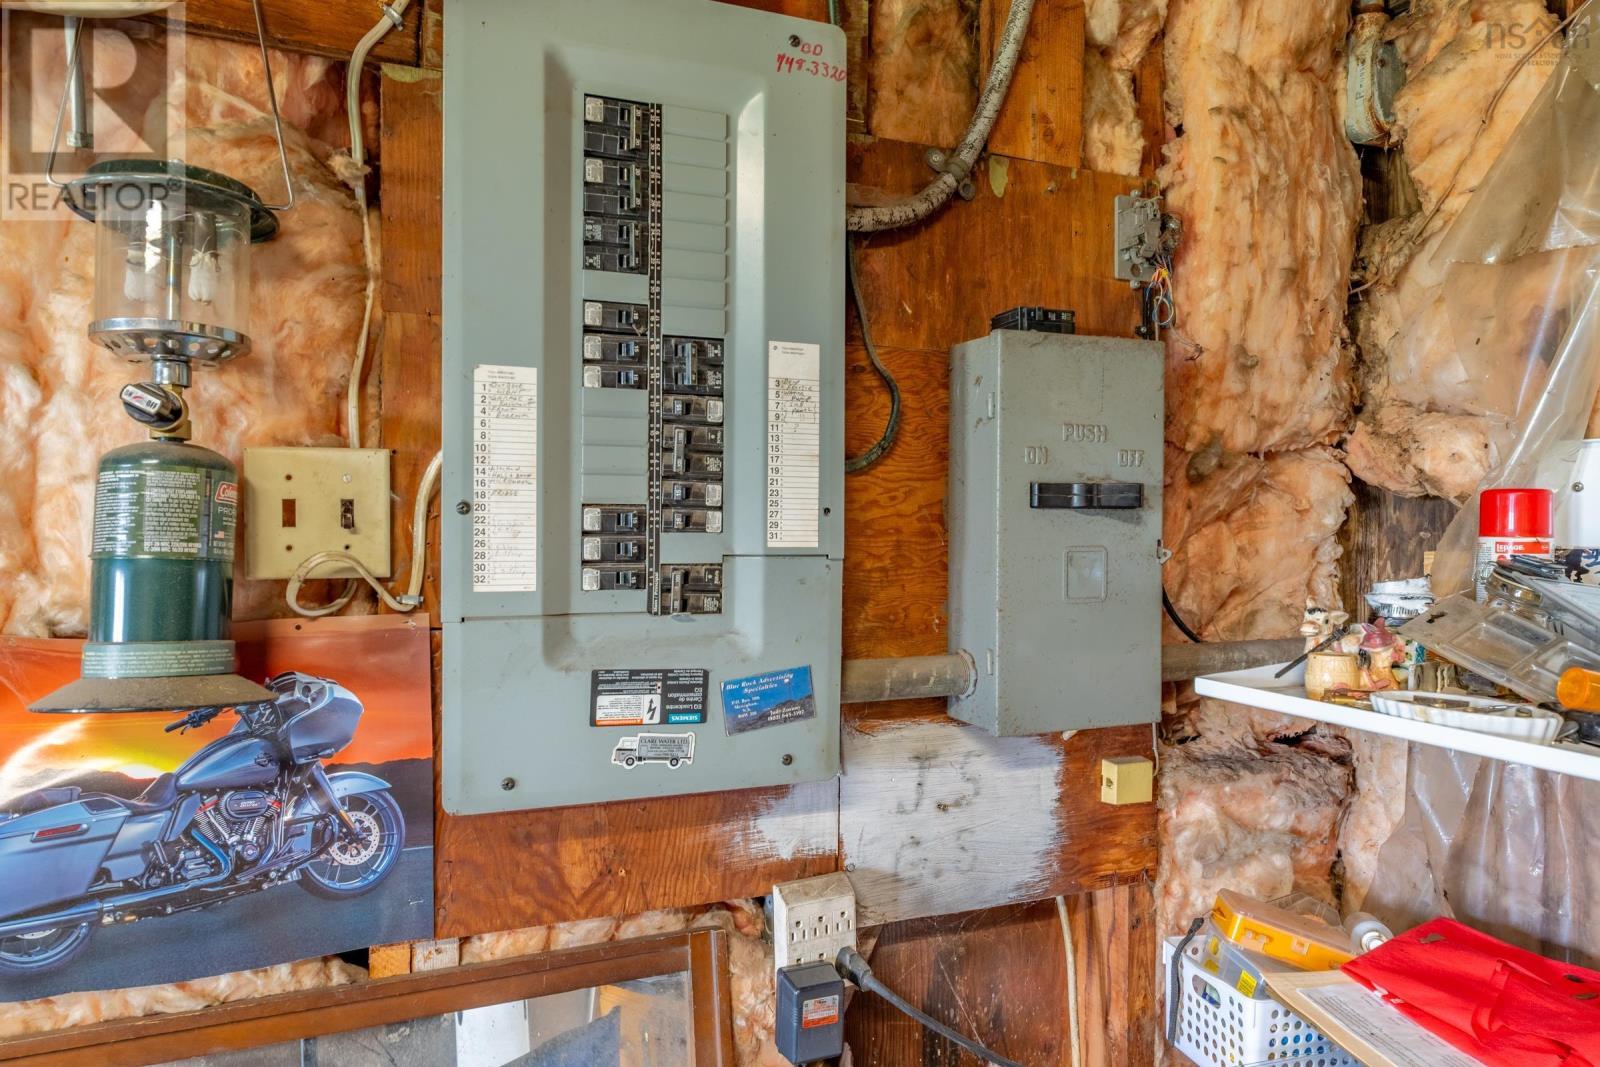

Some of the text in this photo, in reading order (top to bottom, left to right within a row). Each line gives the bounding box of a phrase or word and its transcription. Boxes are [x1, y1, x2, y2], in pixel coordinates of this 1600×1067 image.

[146, 400, 158, 410] OFF
[1062, 423, 1108, 442] PUSH
[475, 444, 486, 452] 10
[1024, 446, 1144, 468] ON OFF
[476, 479, 486, 487] 16
[476, 491, 486, 499] 18
[474, 528, 486, 536] 24
[474, 552, 486, 560] 28
[474, 564, 486, 572] 30
[474, 575, 486, 584] 32
[741, 679, 757, 688] Rock
[760, 673, 794, 684] Advertising
[743, 683, 778, 694] Specialties
